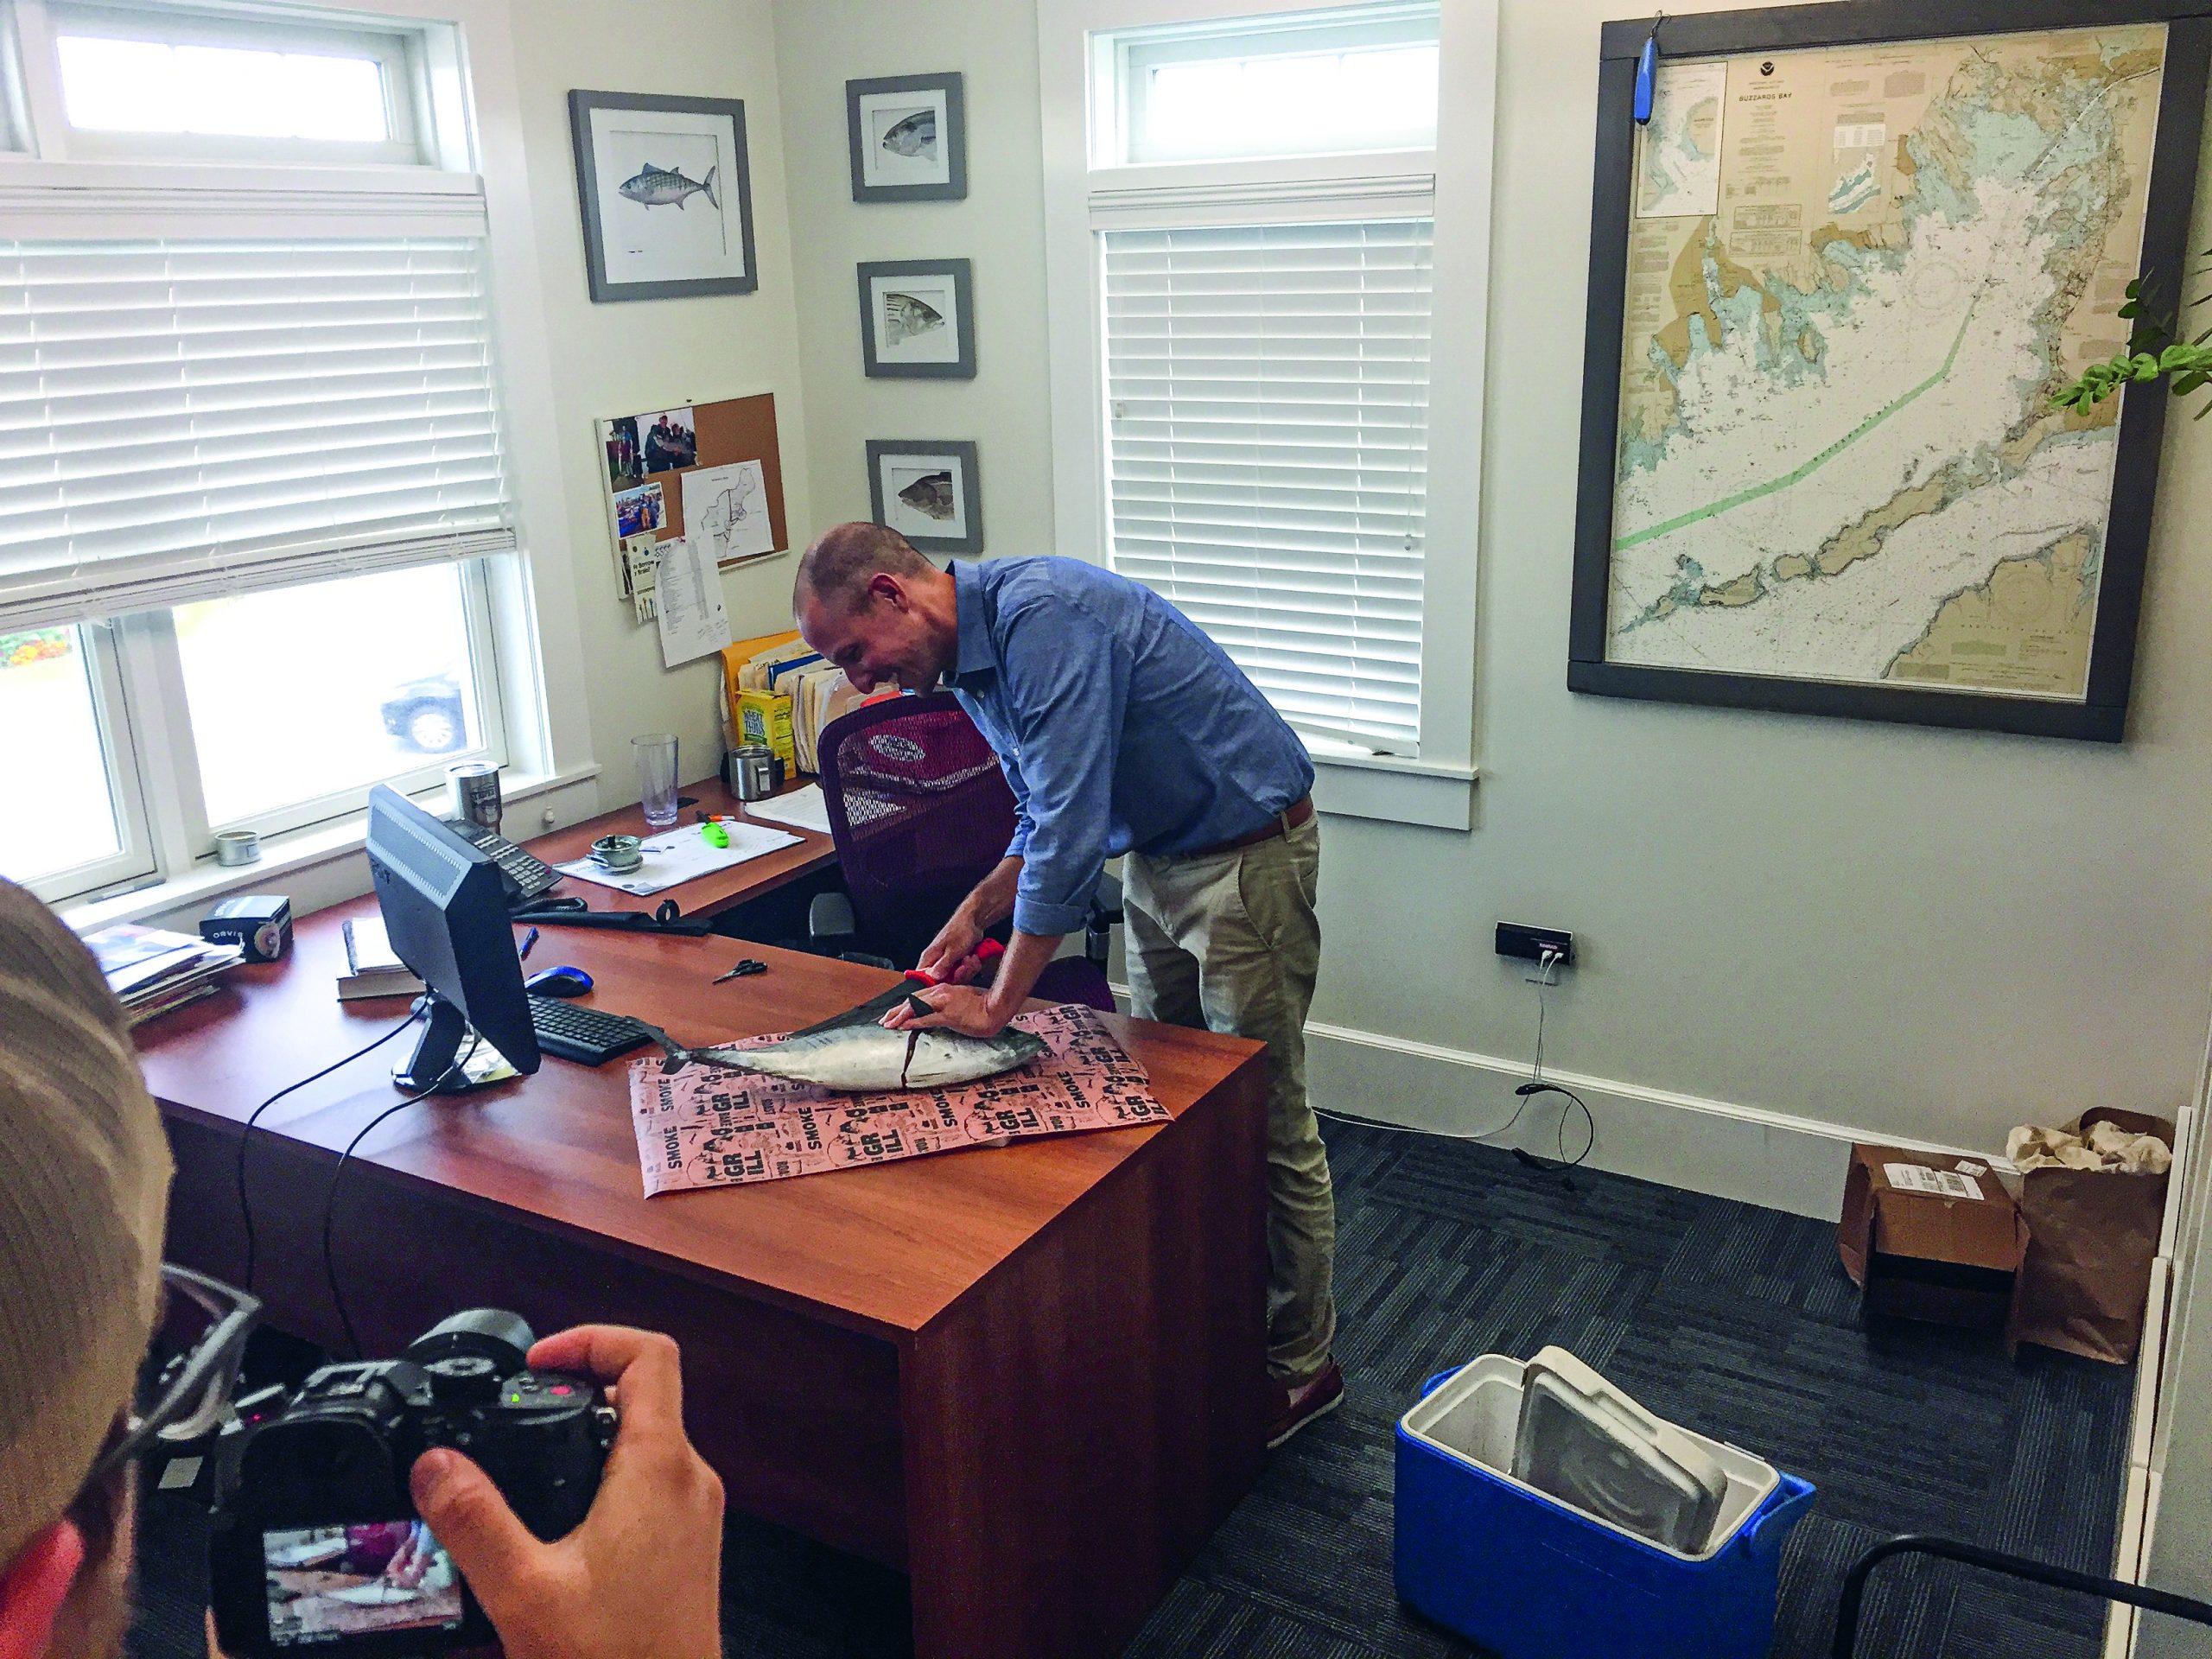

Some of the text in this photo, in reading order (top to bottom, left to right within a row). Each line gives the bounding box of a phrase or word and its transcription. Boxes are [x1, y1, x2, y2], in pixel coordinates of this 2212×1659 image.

[1738, 93, 1776, 102] BUZZARDS
[744, 709, 764, 723] WHEAT
[745, 720, 766, 736] THINS
[213, 931, 244, 939] ORVIS
[659, 1078, 674, 1111] SMOKE
[1058, 1071, 1090, 1109] SMOKE
[800, 1107, 822, 1150] SMOKE
[664, 1126, 682, 1169] SMOKE
